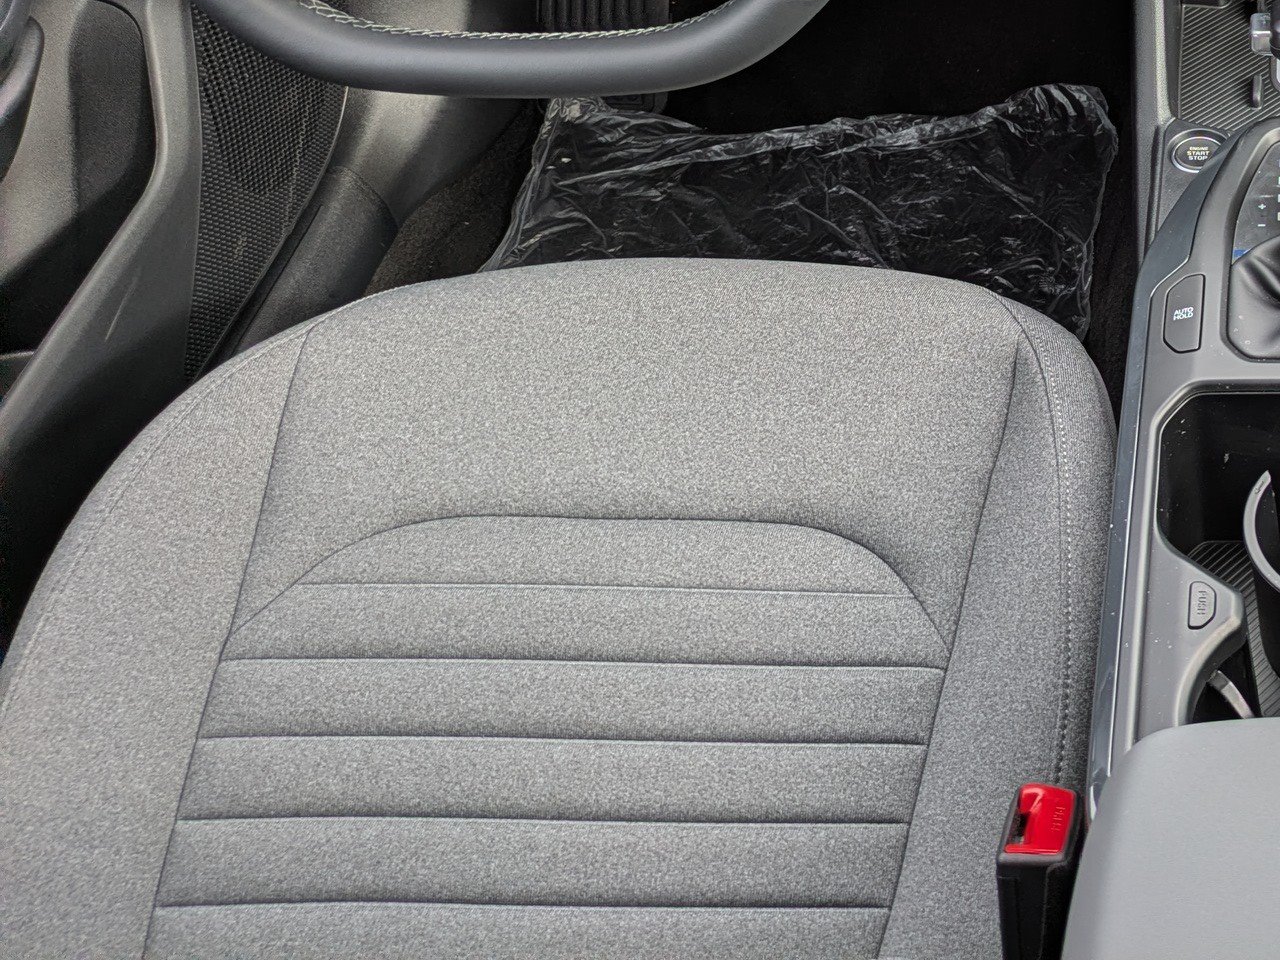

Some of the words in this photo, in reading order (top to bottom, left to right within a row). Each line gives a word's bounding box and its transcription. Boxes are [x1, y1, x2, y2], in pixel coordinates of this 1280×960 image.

[1174, 306, 1194, 316] AUTO
[1173, 312, 1194, 321] HOLD
[1196, 590, 1206, 616] PUSH
